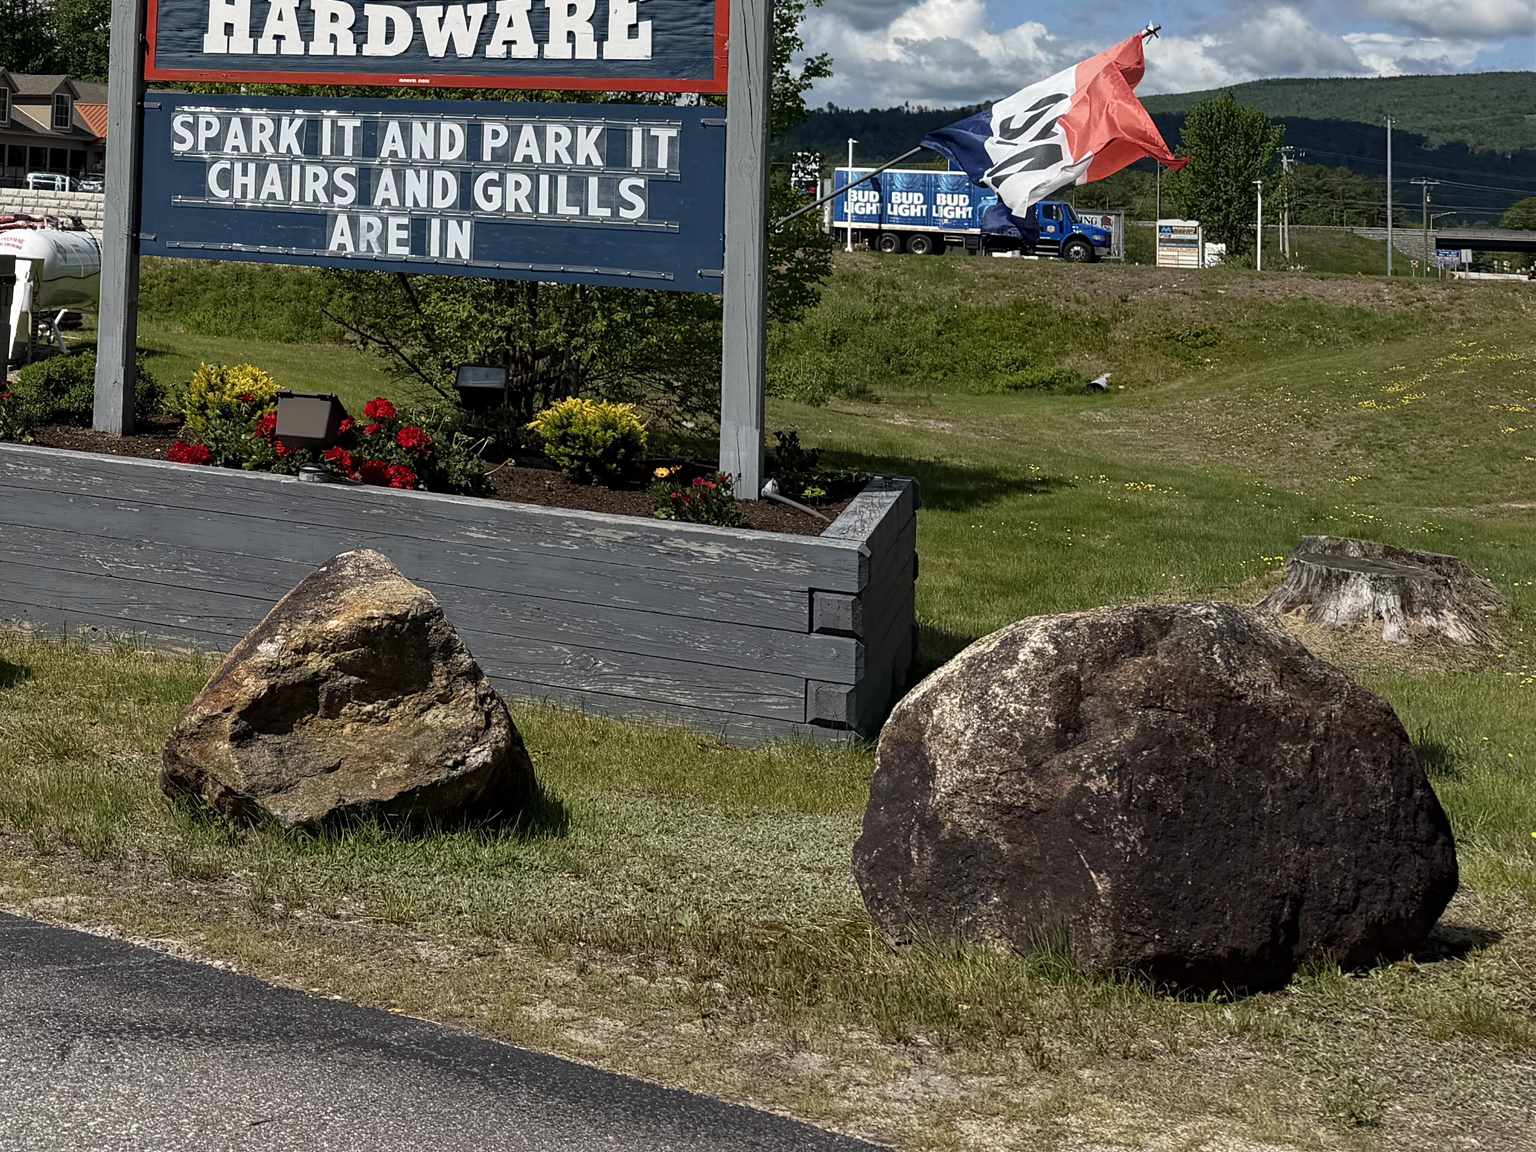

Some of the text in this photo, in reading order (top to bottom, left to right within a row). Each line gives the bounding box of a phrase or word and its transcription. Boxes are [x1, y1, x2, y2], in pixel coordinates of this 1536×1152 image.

[172, 114, 678, 169] SPARK IT AND PARK IT
[207, 160, 646, 219] CHAIRS AND GRILLS
[848, 189, 880, 203] BUD
[891, 191, 924, 204] BUD
[936, 193, 969, 206] BUD
[887, 203, 927, 217] LIGHT
[932, 205, 973, 219] LIGHT
[328, 213, 471, 260] ARE IN
